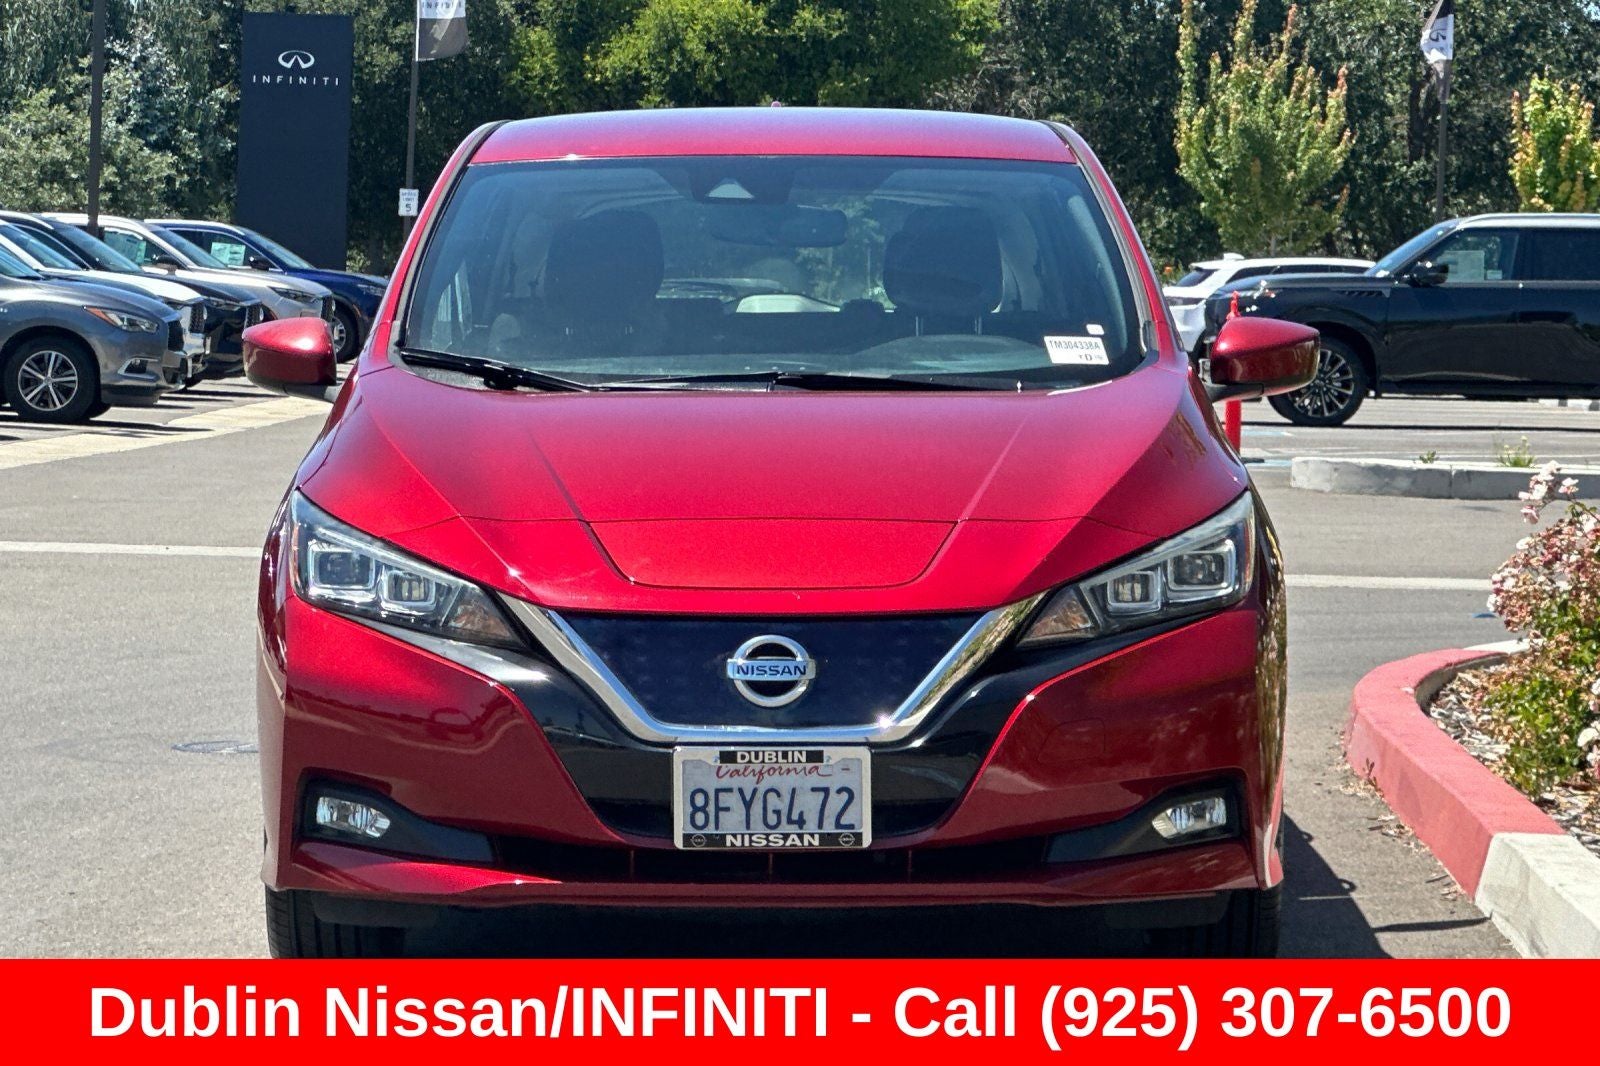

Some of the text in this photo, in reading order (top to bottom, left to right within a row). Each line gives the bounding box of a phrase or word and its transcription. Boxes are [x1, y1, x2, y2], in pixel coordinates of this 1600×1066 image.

[252, 74, 339, 86] INFINITI
[405, 203, 412, 212] 5
[736, 664, 807, 676] NISSAN
[736, 751, 807, 764] DUBLIN
[715, 764, 833, 785] California
[689, 786, 856, 831] 8FYG472
[725, 833, 820, 847] NISSAN
